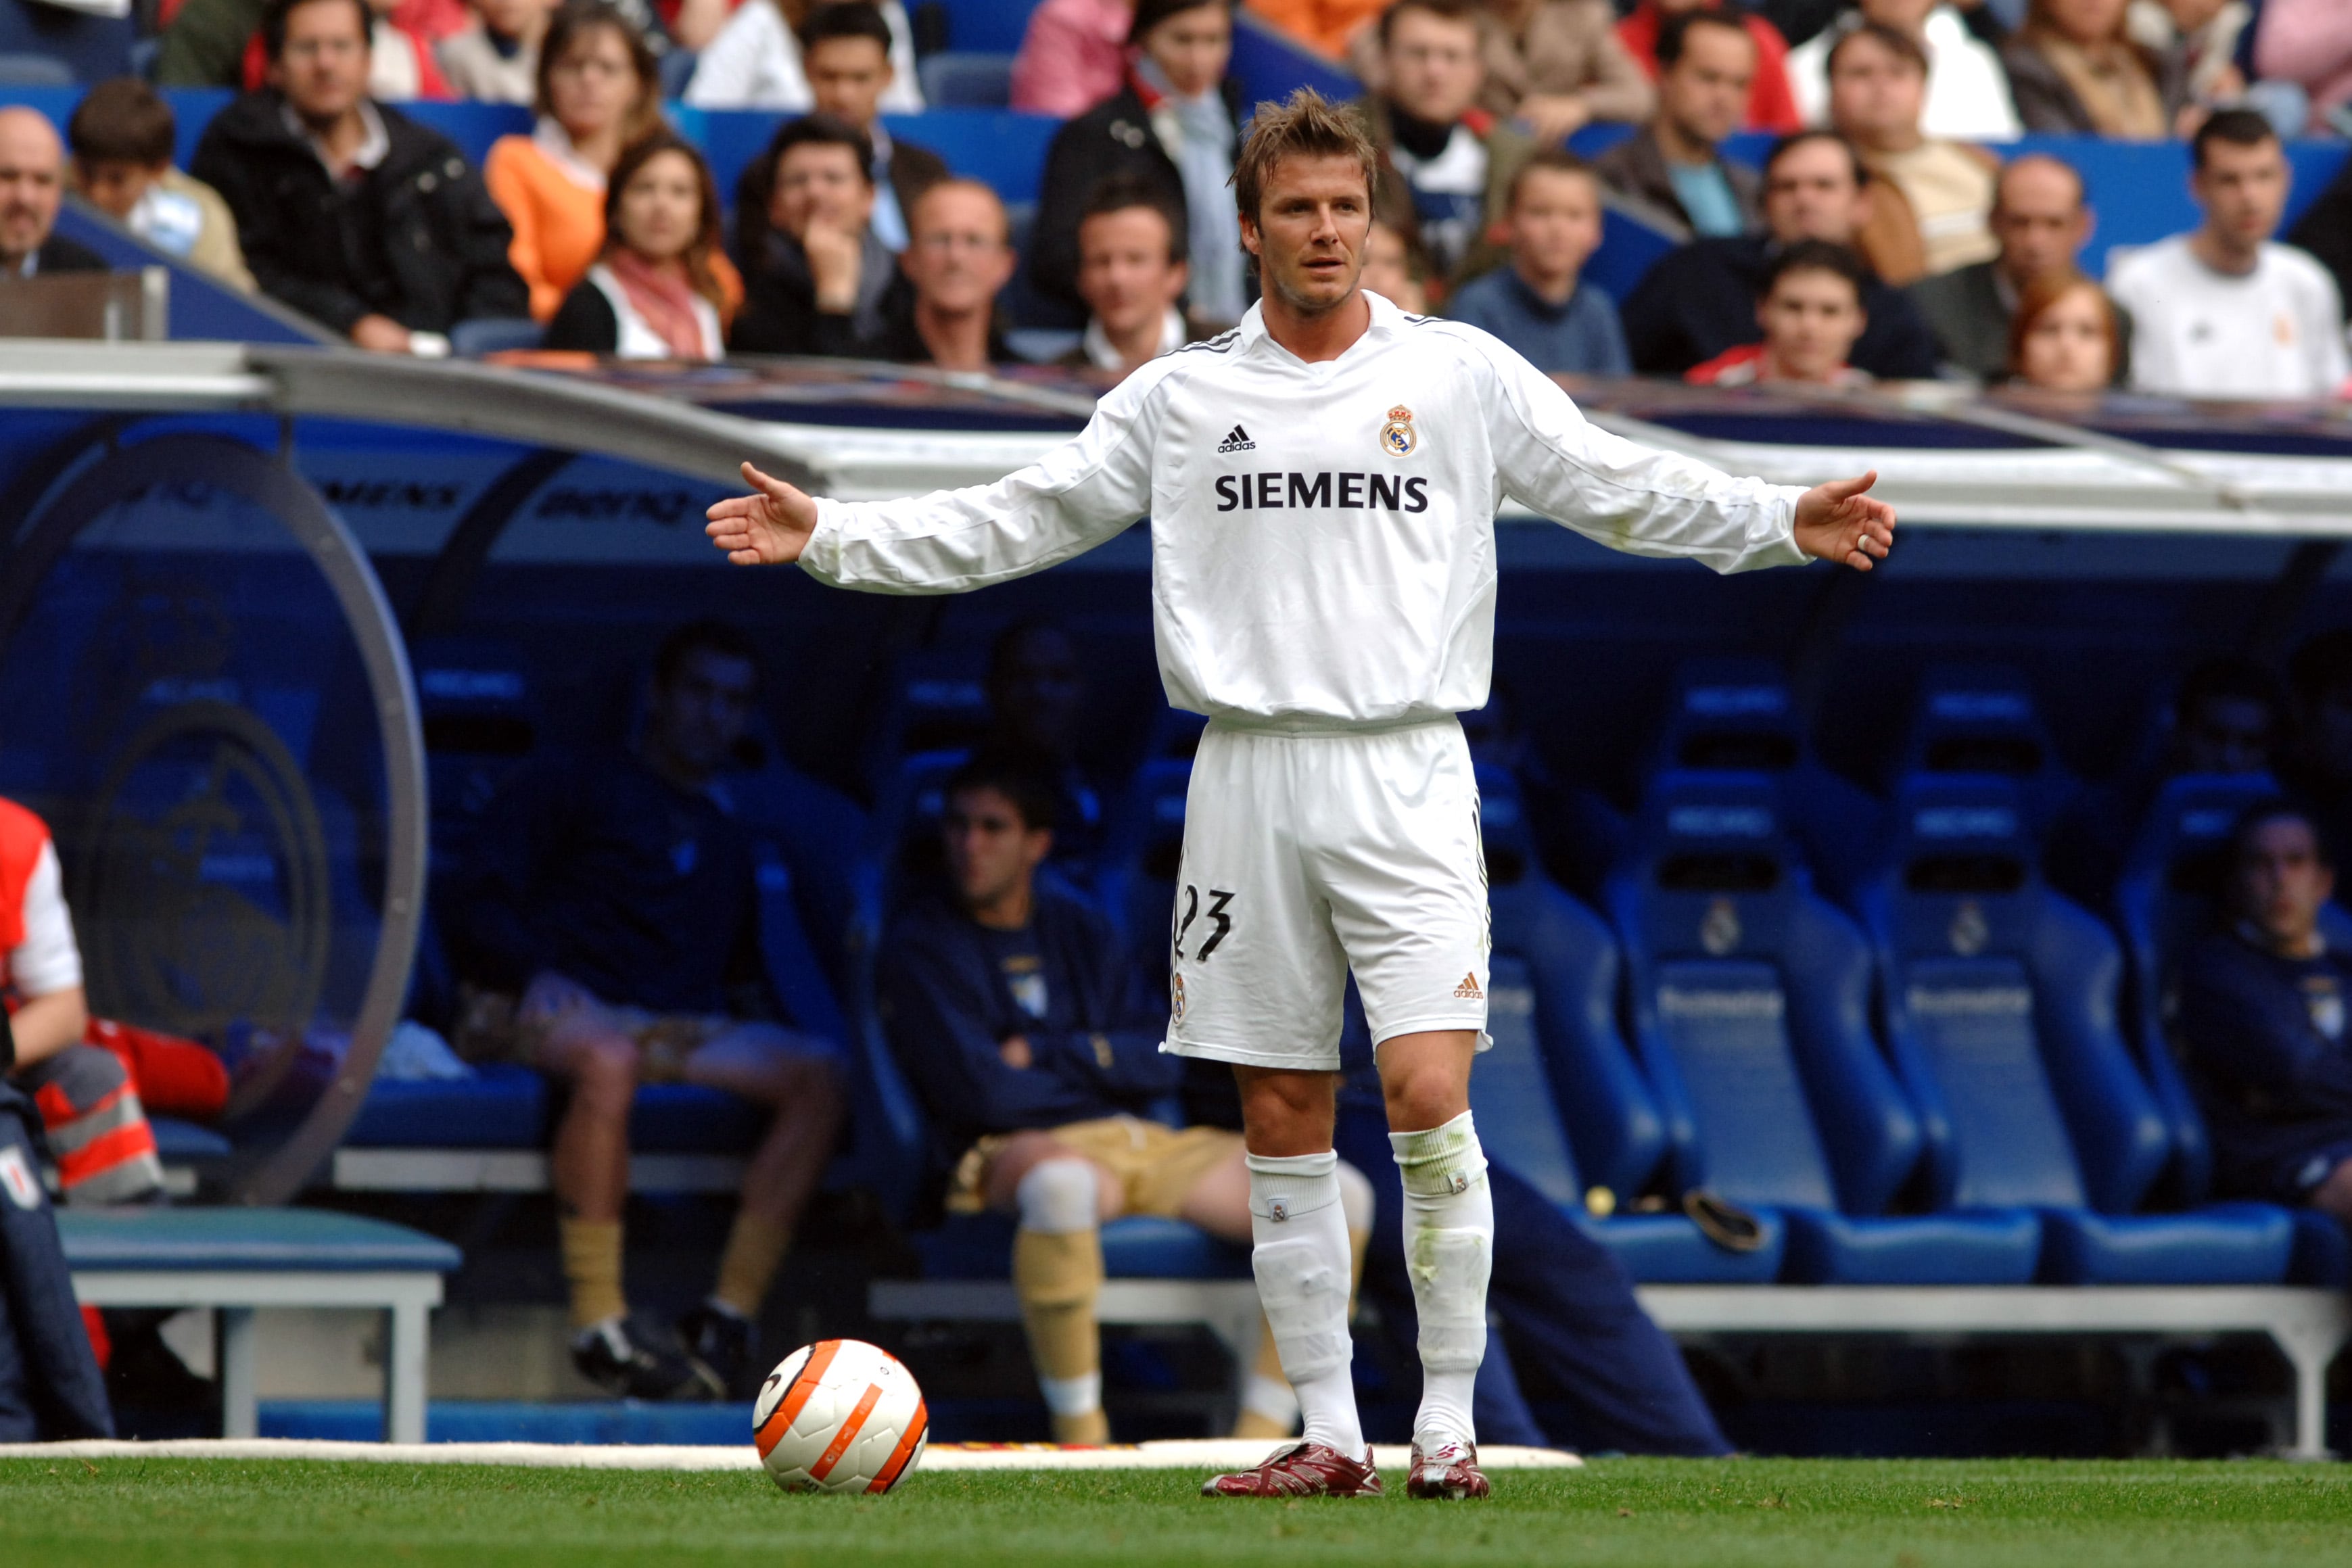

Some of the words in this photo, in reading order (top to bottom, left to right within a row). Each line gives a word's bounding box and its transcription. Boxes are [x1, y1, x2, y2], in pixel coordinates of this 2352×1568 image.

[1217, 441, 1256, 453] adidas
[1216, 472, 1428, 513] SIEMENS
[1177, 884, 1236, 961] 23
[1453, 988, 1484, 999] adidas
